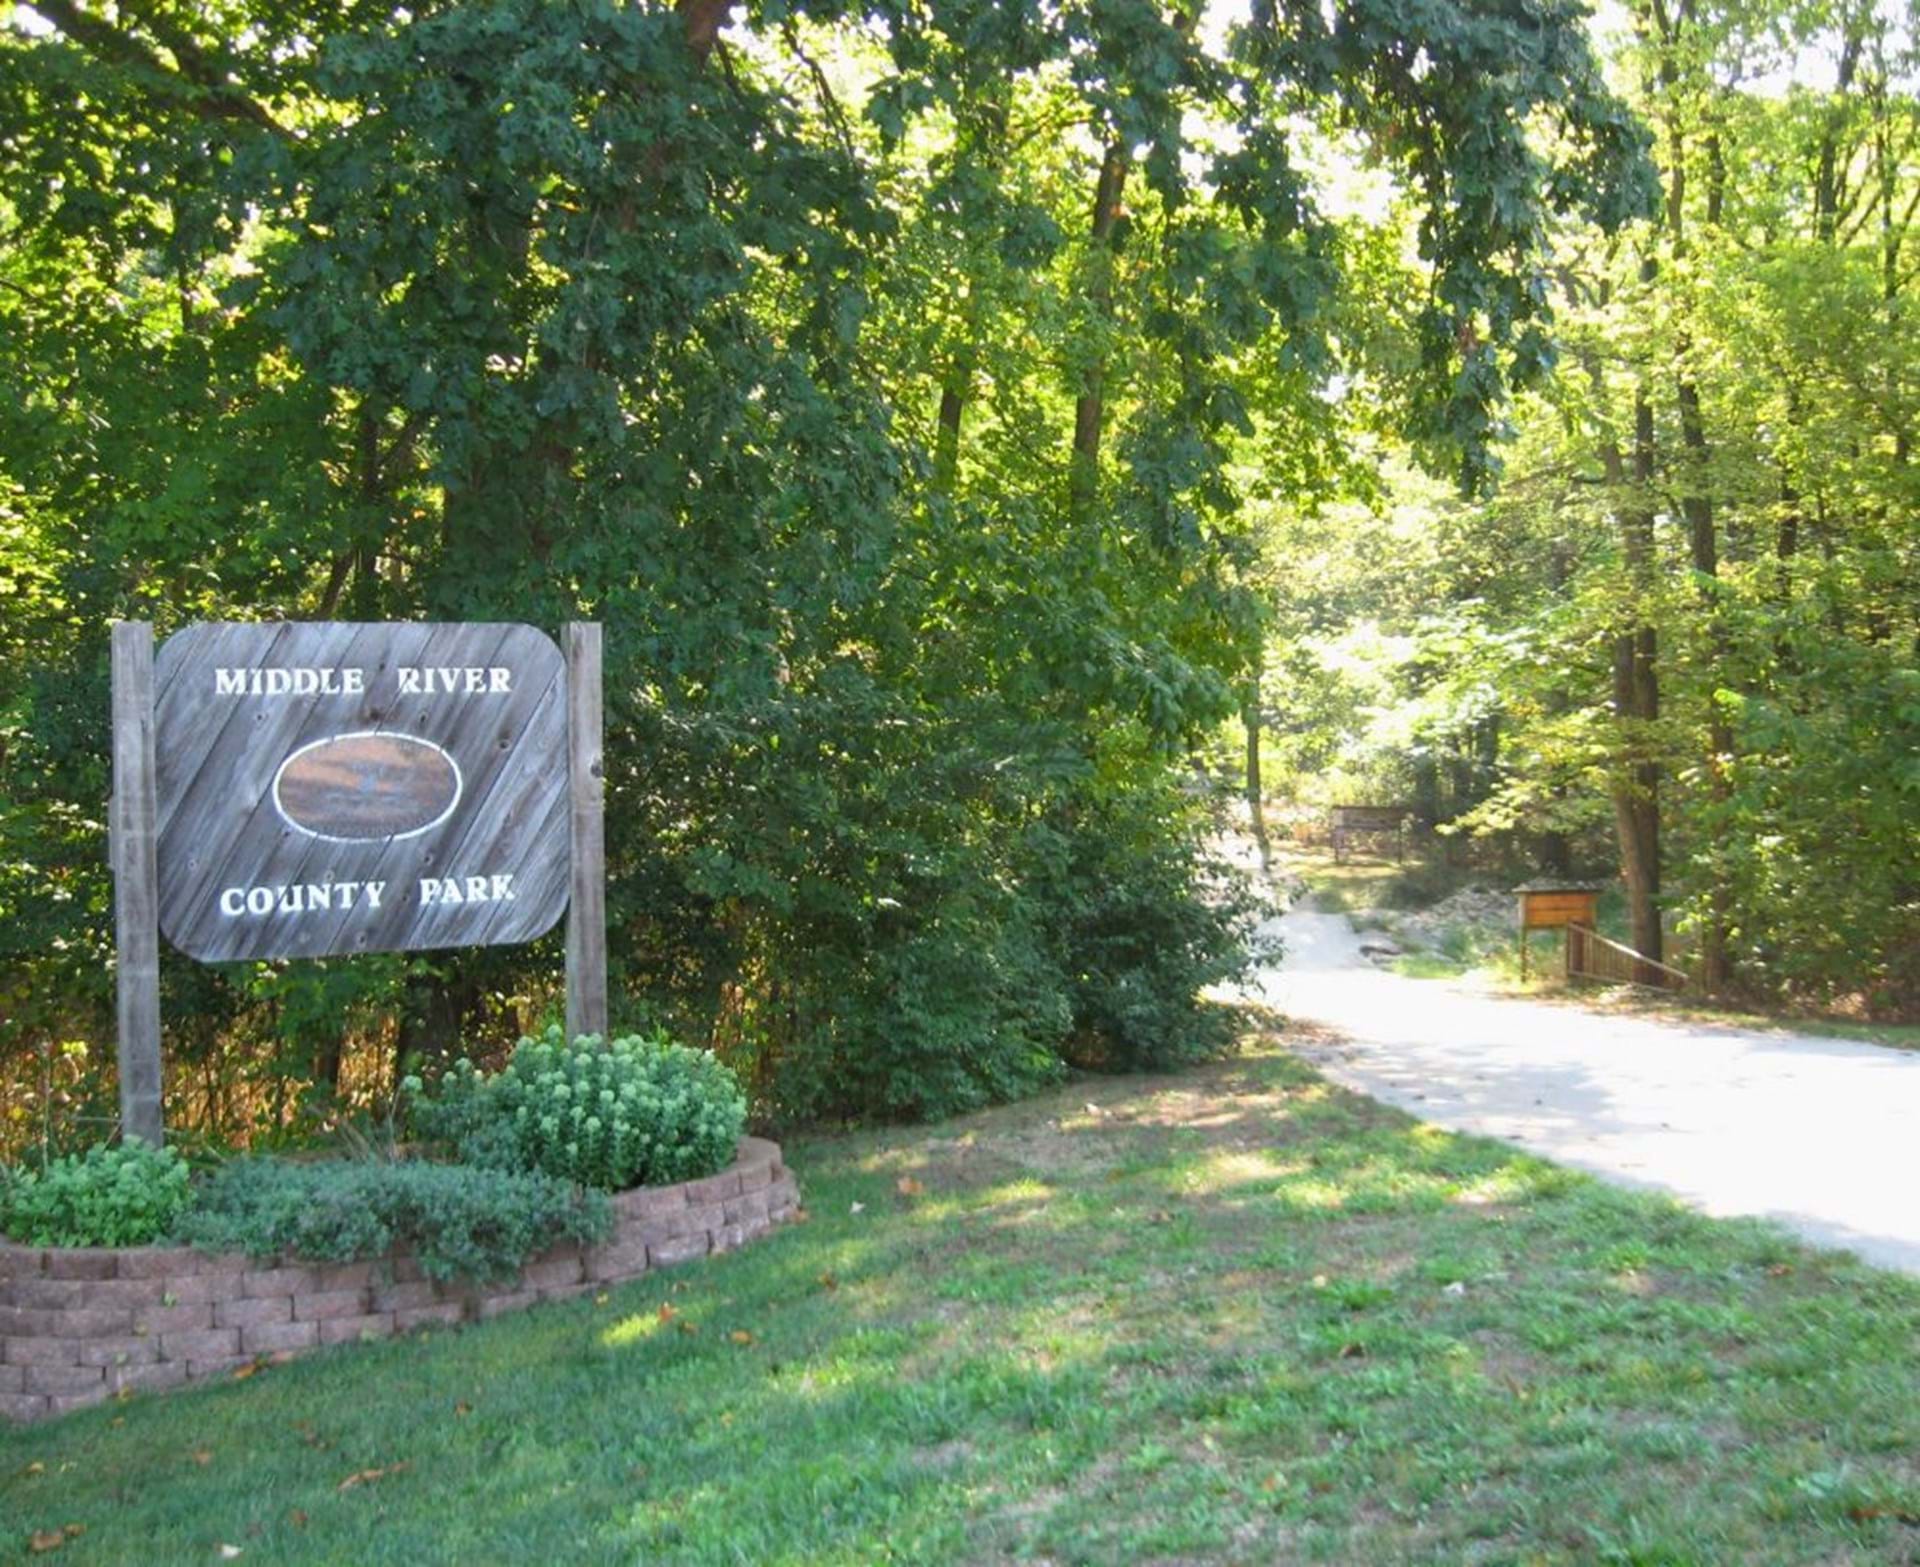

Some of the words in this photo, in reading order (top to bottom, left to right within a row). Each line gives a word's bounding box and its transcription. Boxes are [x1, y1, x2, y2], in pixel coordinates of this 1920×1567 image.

[214, 667, 365, 695] MIDDLE
[398, 666, 513, 694] RIVER
[220, 883, 386, 916] COUNTY
[420, 874, 516, 905] PARK
